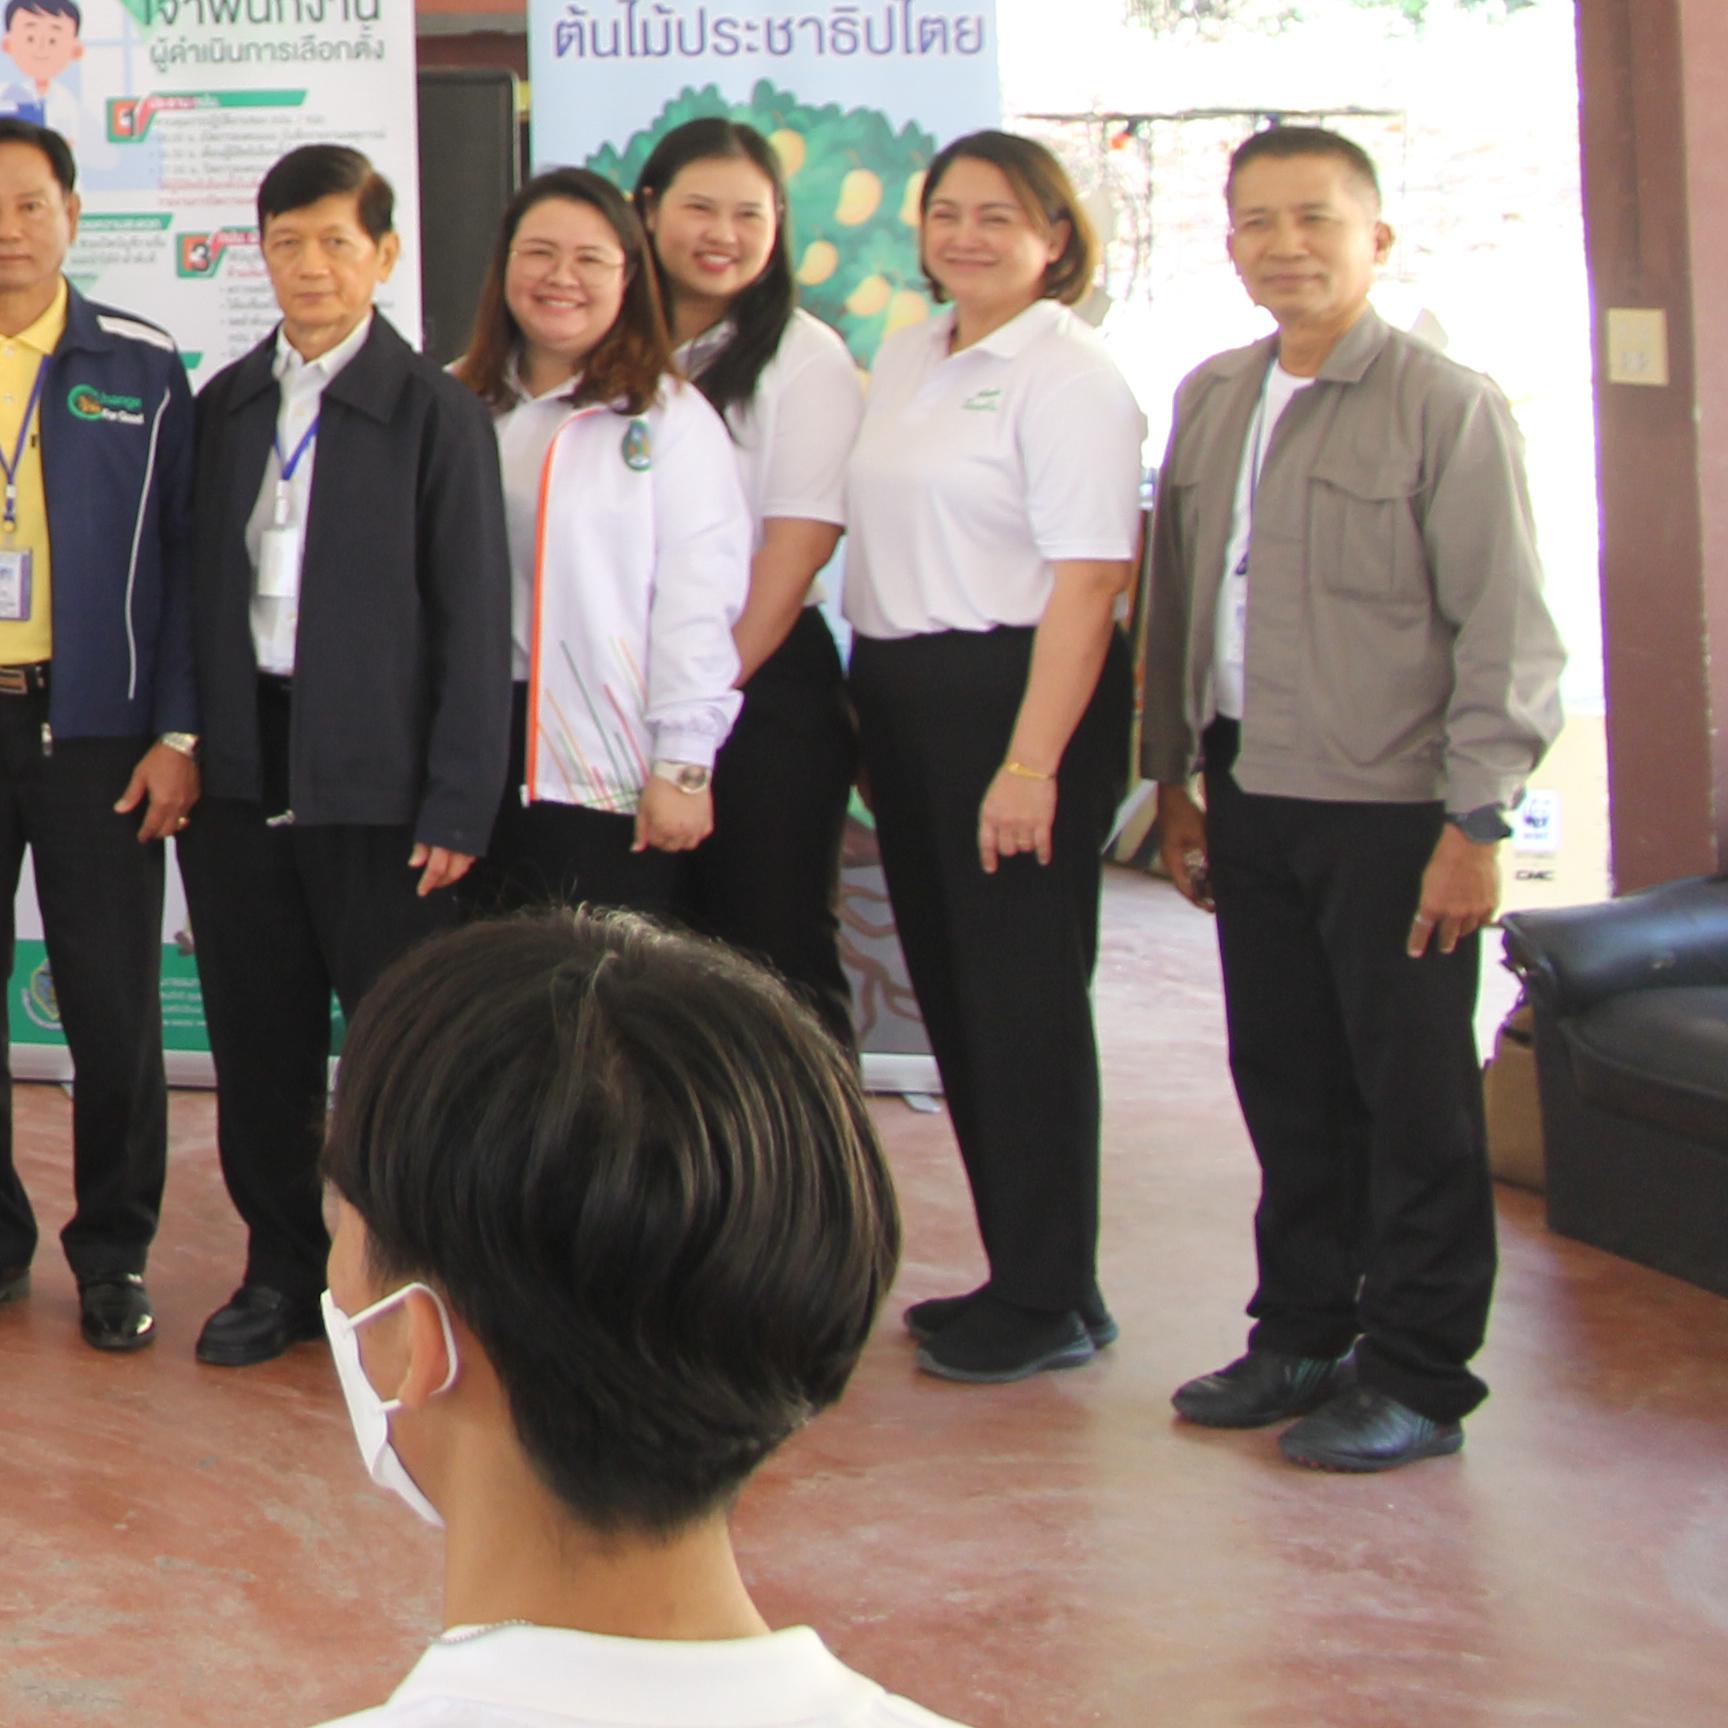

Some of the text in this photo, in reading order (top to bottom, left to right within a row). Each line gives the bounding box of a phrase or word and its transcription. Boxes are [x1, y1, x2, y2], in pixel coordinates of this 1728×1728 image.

[149, 25, 385, 72] ผู้ดำเนินการเลือกตั้ง
